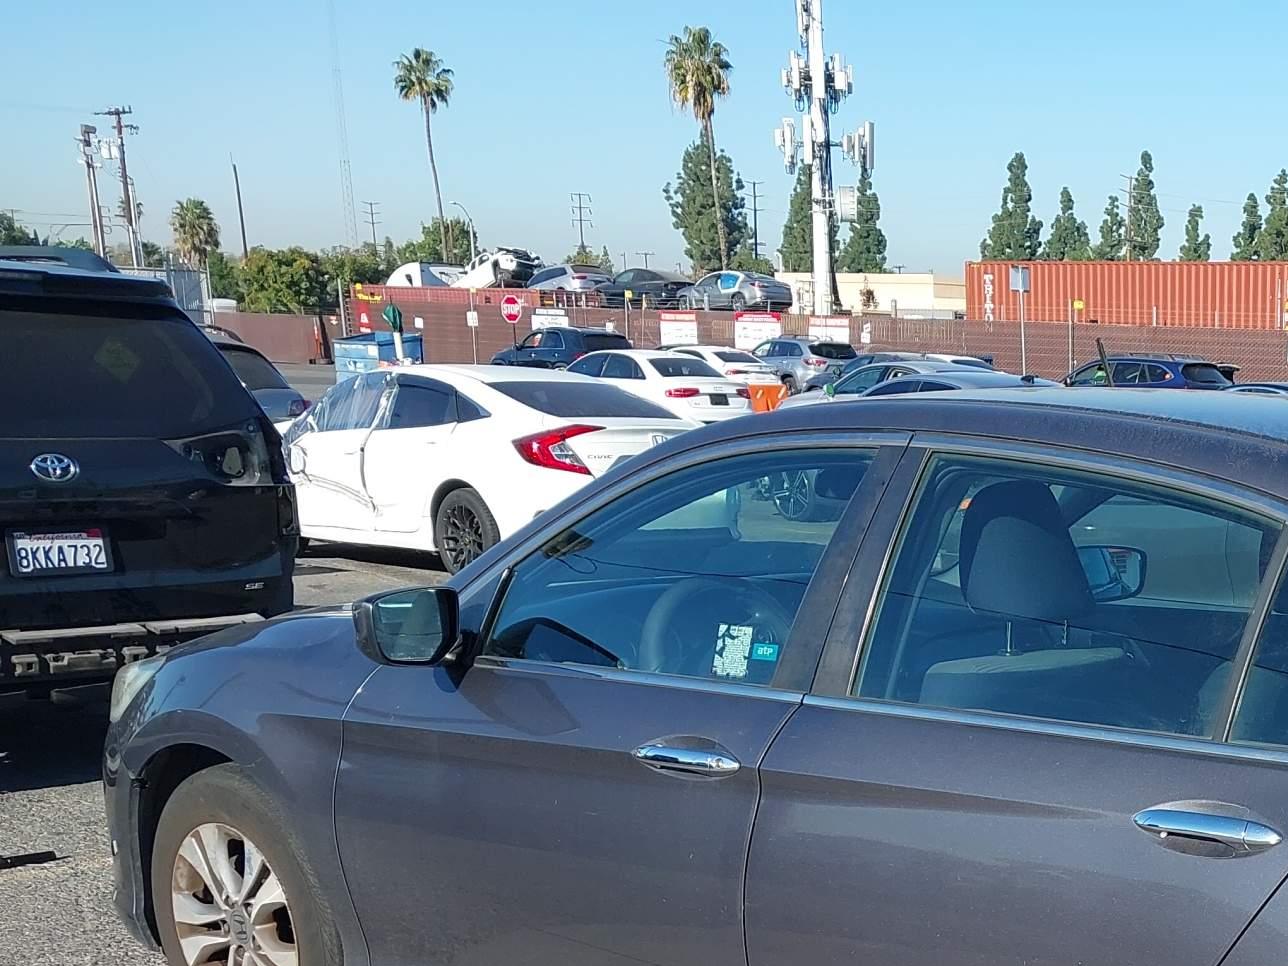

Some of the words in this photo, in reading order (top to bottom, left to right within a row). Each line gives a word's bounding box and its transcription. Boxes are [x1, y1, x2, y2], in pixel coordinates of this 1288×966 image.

[503, 303, 519, 314] STOP
[17, 544, 106, 569] 8KKA732
[245, 582, 265, 590] SE
